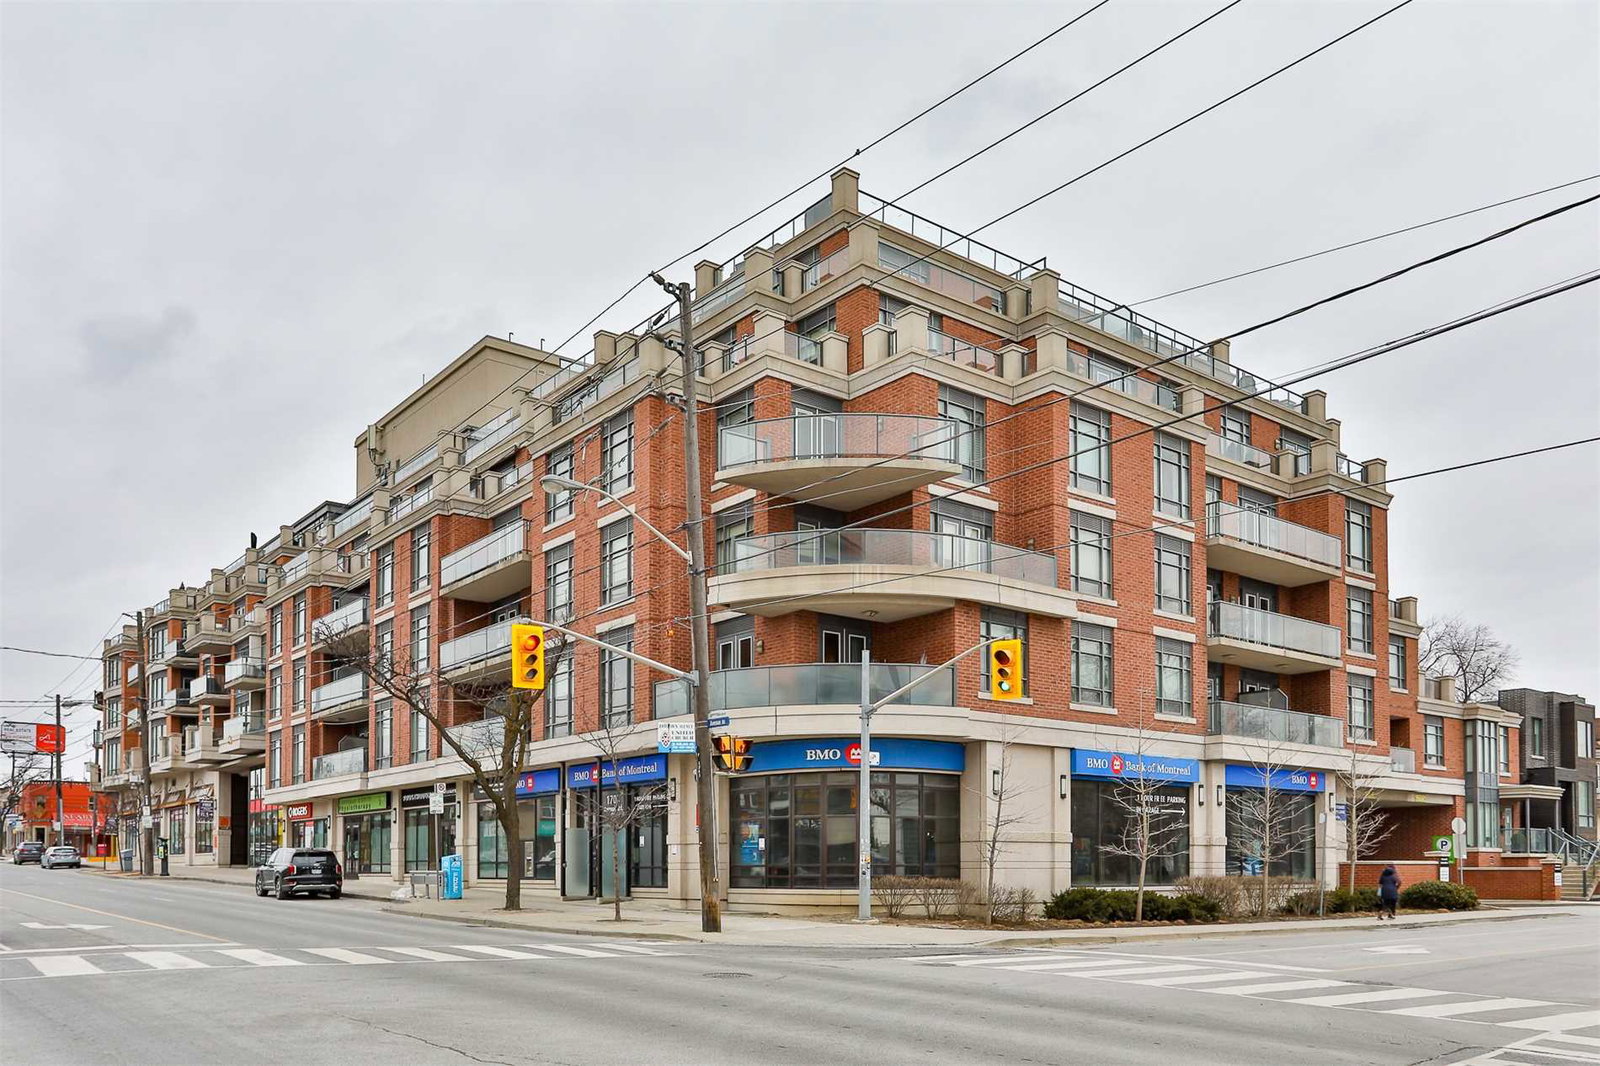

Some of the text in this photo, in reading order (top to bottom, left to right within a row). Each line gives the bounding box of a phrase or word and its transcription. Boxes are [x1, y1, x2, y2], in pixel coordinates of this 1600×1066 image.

[806, 748, 841, 761] BMO
[573, 770, 590, 781] BMO
[618, 767, 626, 777] of
[626, 762, 658, 776] Montreal
[1087, 757, 1191, 776] BMO Bank of Montreal
[1291, 775, 1308, 785] BMO
[1167, 796, 1186, 804] PARKING
[293, 806, 308, 816] ROGERS
[1440, 840, 1448, 849] P
